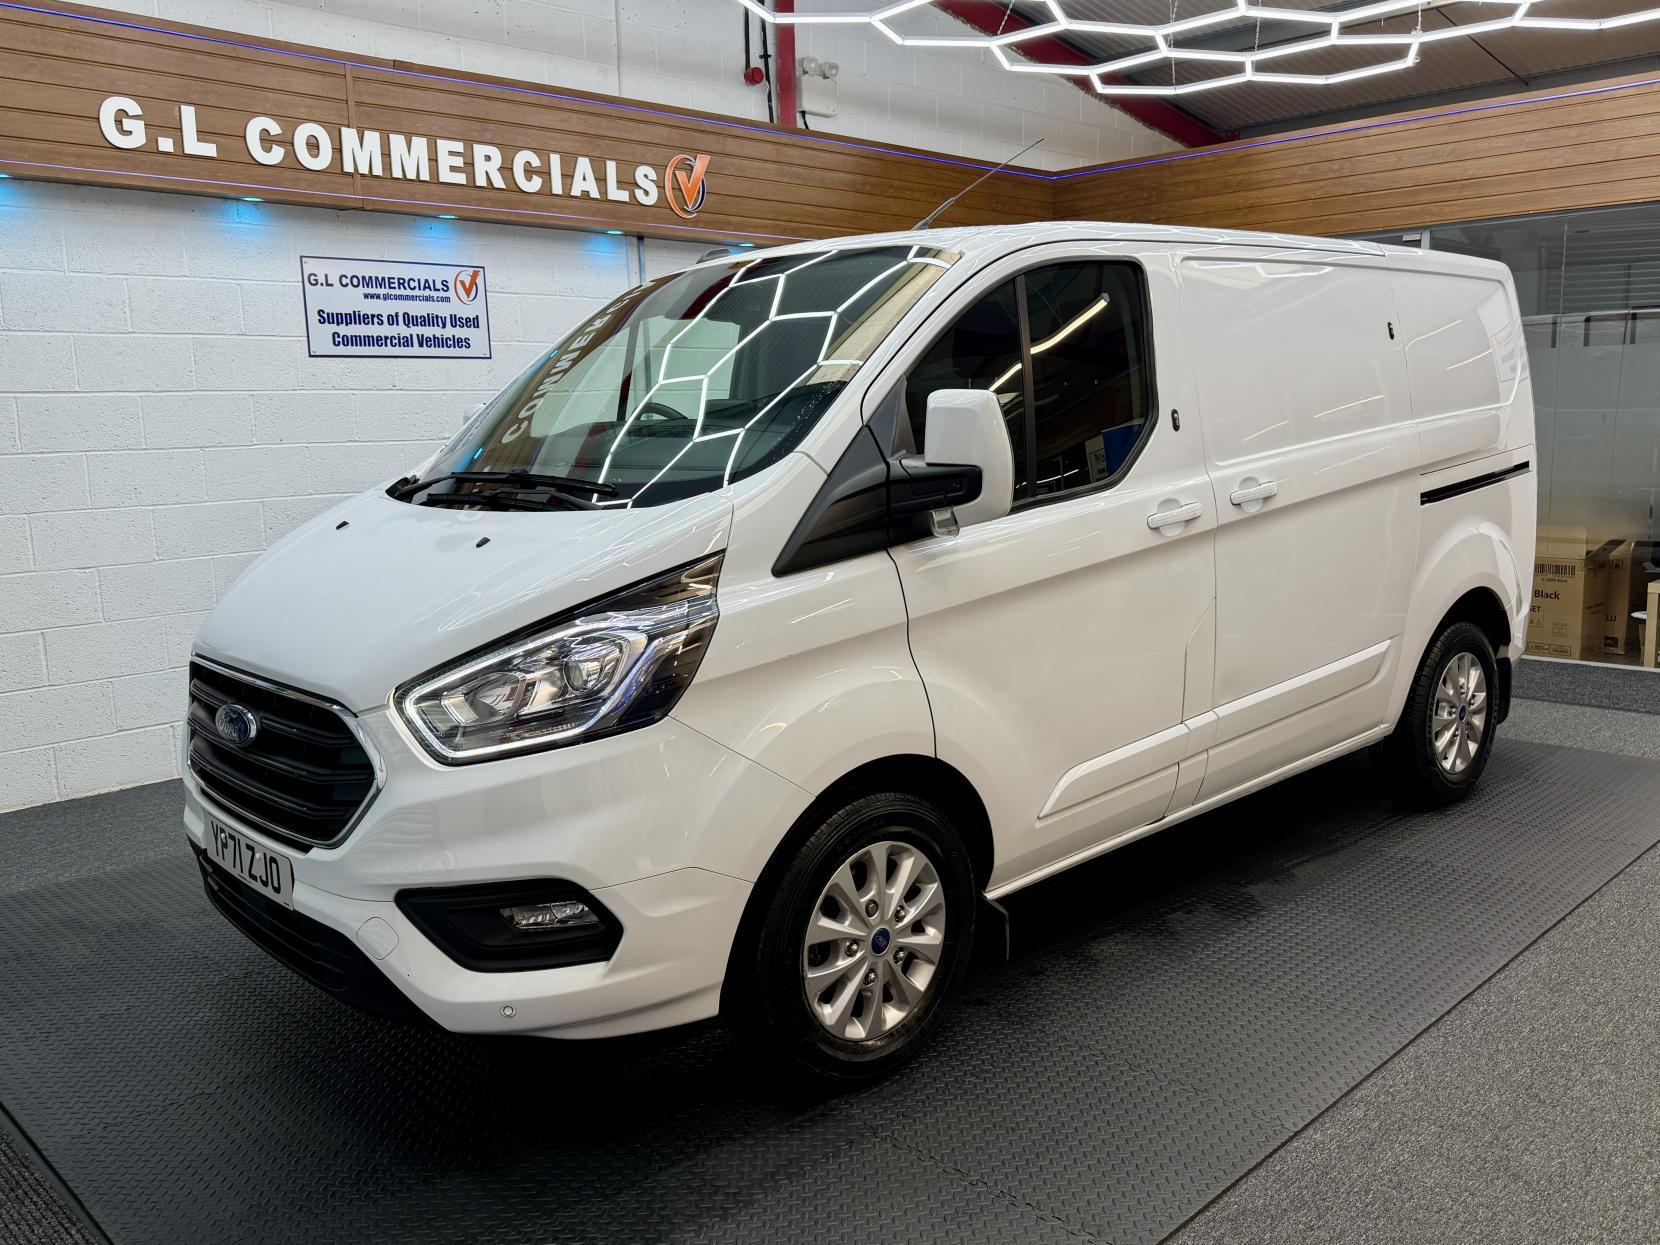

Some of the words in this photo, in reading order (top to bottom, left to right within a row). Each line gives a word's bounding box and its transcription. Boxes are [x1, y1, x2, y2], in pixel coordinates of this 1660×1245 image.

[98, 96, 218, 158] G.L
[245, 116, 660, 207] COMMERCIALS
[307, 272, 334, 287] G.L
[339, 274, 450, 292] COMMERCIALS
[363, 291, 451, 303] www.glcommercials.com
[317, 309, 384, 327] Suppliers
[387, 311, 399, 326] of
[403, 311, 447, 329] Quality
[450, 313, 480, 329] Used
[332, 331, 414, 348] Commercial
[416, 333, 471, 349] Vehicles
[1534, 589, 1561, 600] Black
[211, 821, 244, 874] YP71
